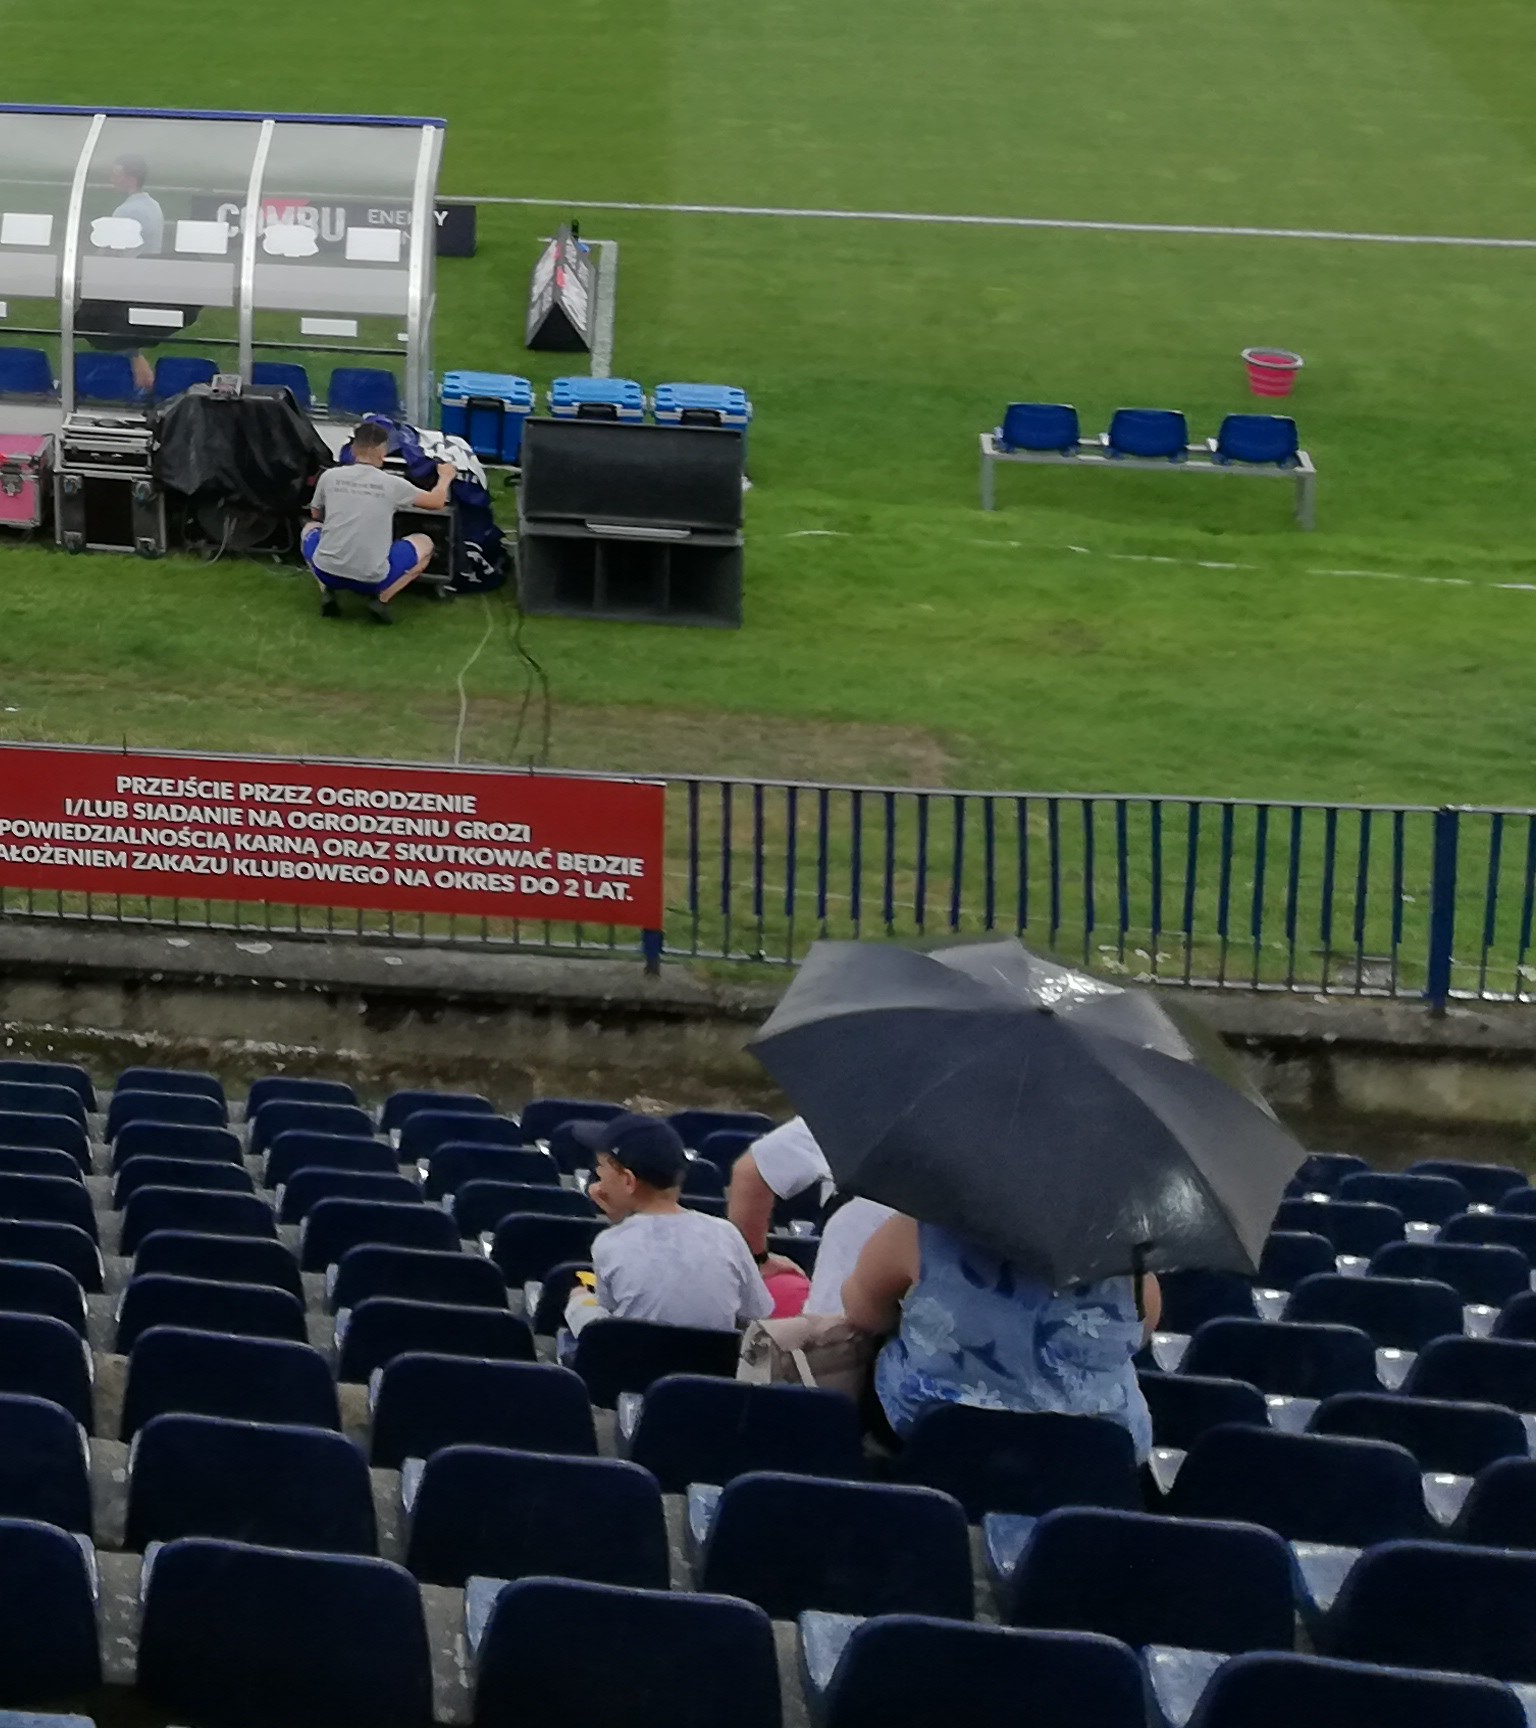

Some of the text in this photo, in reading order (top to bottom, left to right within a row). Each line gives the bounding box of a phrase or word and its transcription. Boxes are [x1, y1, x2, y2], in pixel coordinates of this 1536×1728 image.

[116, 775, 477, 814] PRZEJŚCIE PRZEZ OGRODZENIE
[64, 797, 532, 843] I/LUB SIADANIE NA OGRODZENIU GROZI
[131, 851, 229, 875] ZAKAZU
[233, 857, 390, 885] KLUBOWEGO
[394, 867, 431, 888] NA
[433, 870, 517, 893] OKRES
[519, 874, 560, 896] DO
[562, 878, 580, 897] 2
[583, 880, 634, 902] LAT.
[233, 832, 320, 859] KARNĄ
[322, 839, 391, 860] ORAZ
[394, 841, 553, 870] SKUTKOWAĆ
[556, 851, 645, 878] BĘDZIE
